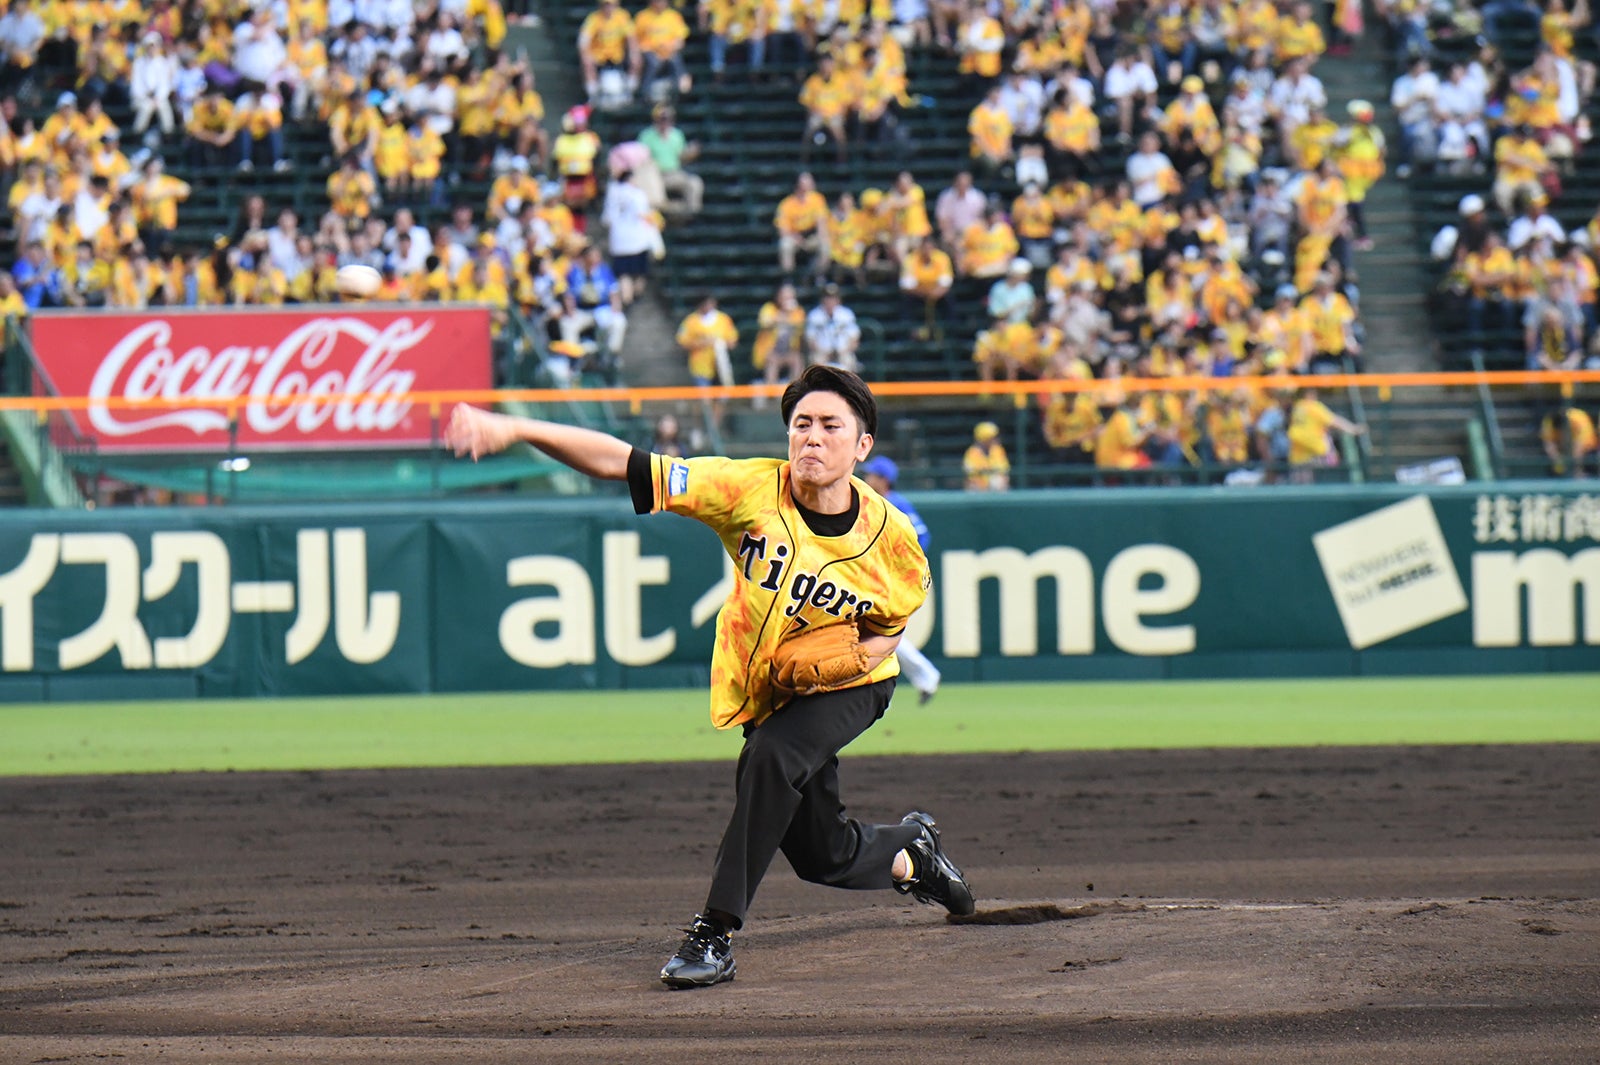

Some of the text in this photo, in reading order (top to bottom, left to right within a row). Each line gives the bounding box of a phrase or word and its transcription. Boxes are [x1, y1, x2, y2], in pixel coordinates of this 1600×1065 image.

[87, 317, 434, 436] Coca-Cola
[500, 532, 676, 668] at
[737, 530, 874, 621] Tigers
